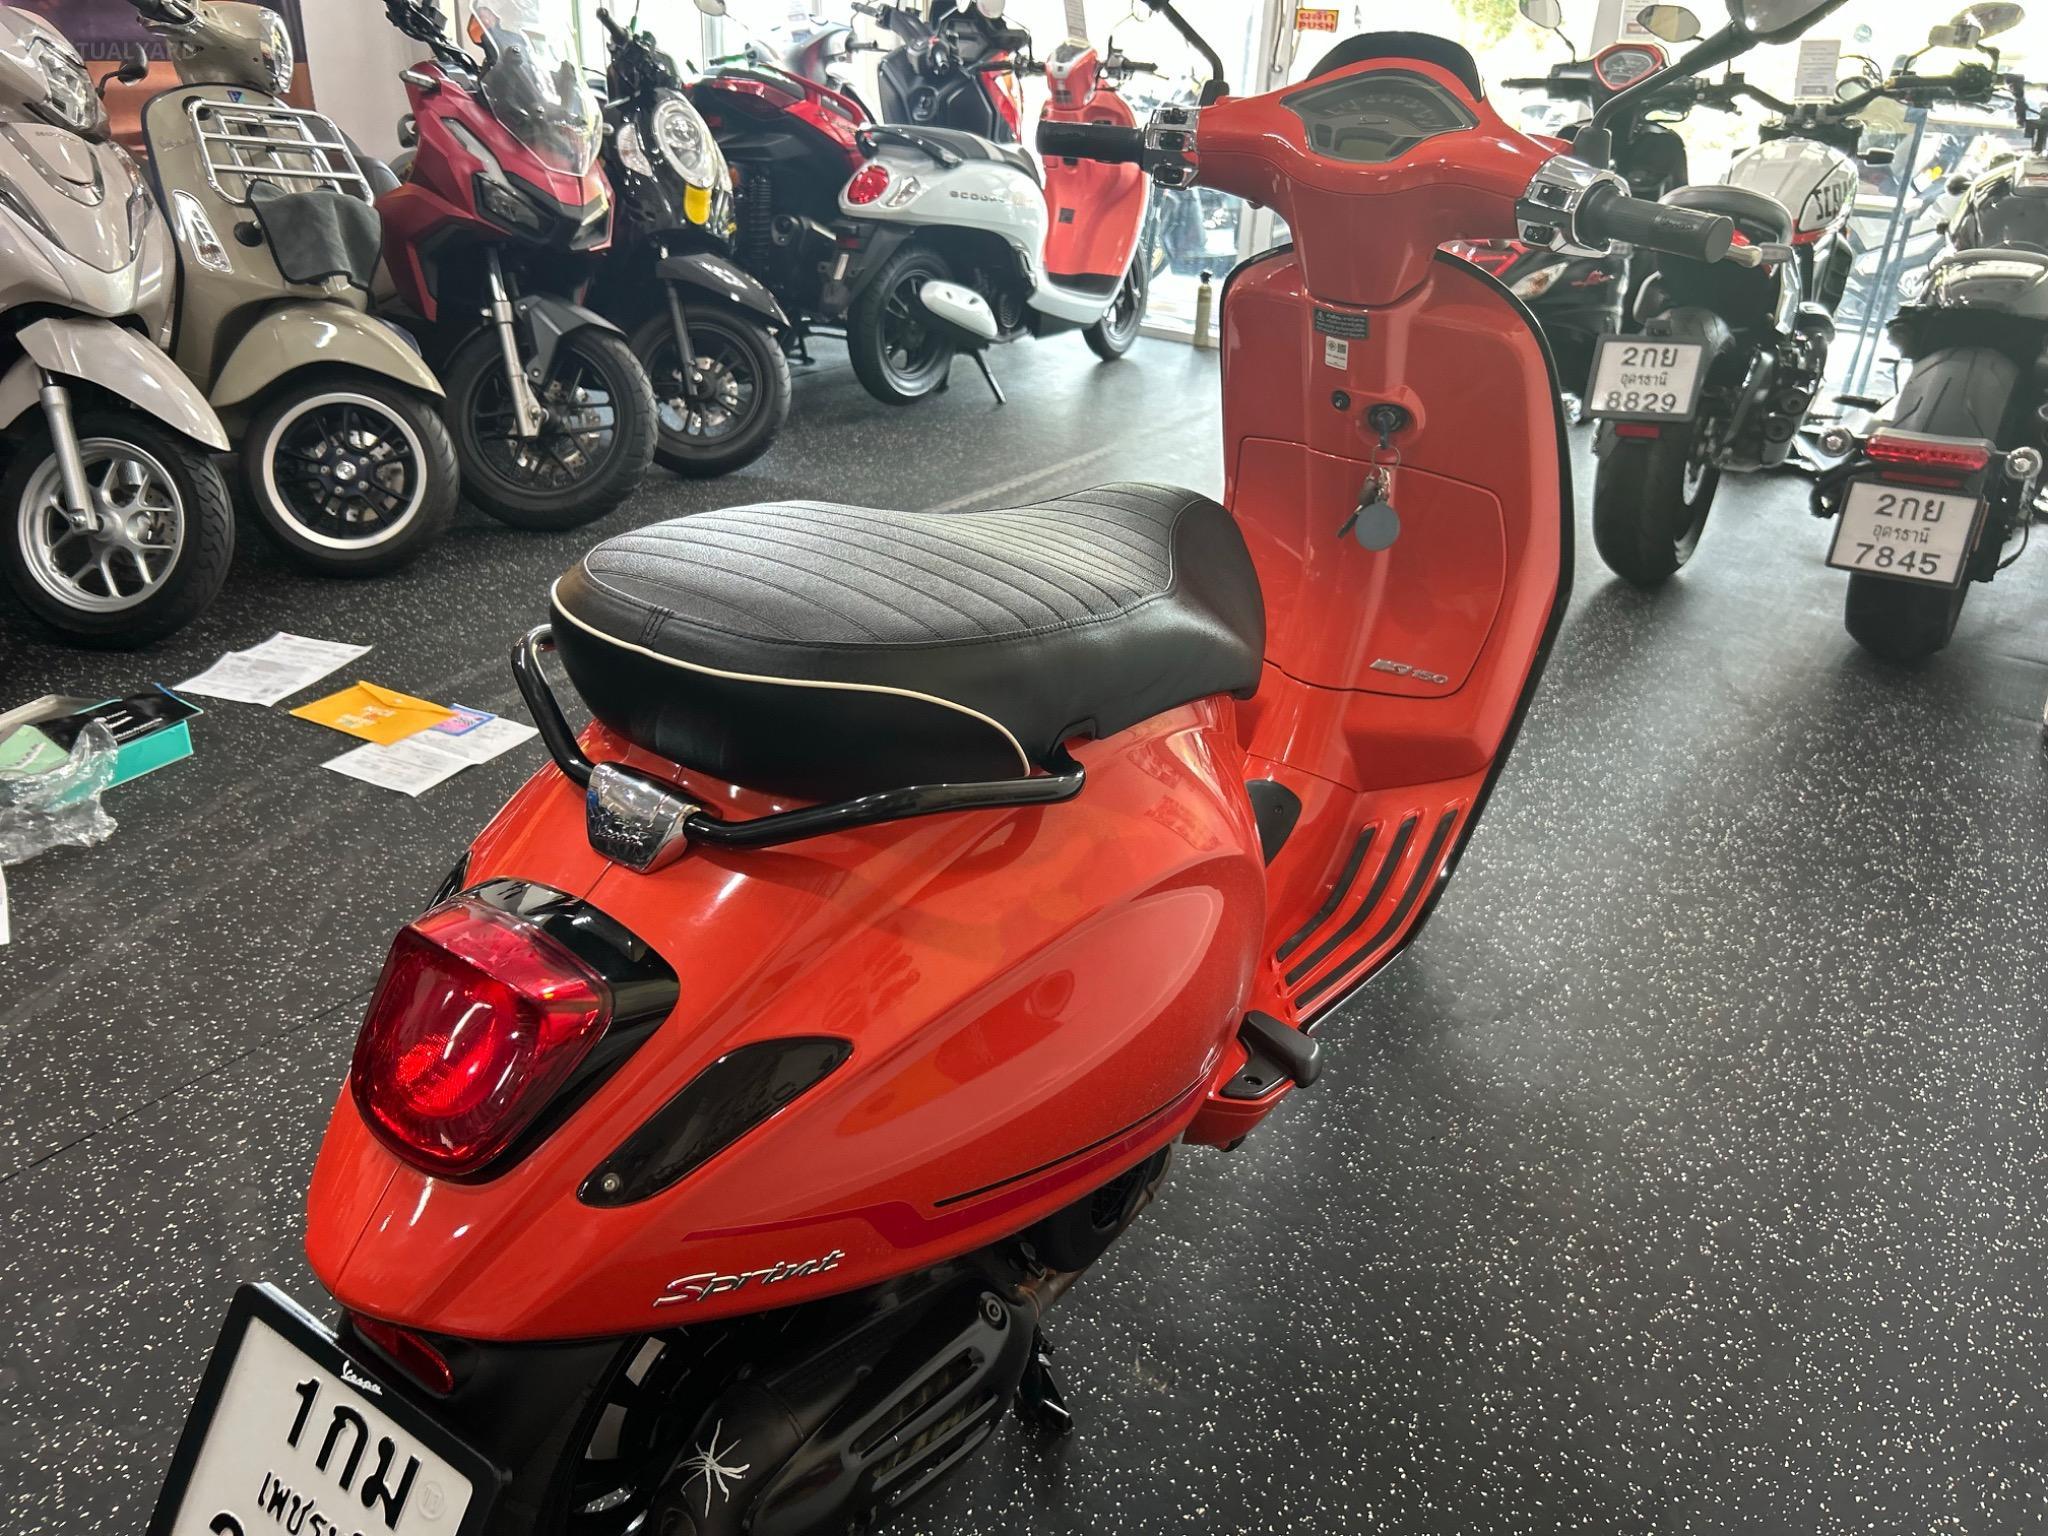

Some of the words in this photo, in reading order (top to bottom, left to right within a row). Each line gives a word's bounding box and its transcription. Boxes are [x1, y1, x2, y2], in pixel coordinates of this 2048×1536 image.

[1298, 21, 1335, 31] PUSH
[1620, 345, 1678, 368] 2กย
[1606, 391, 1677, 413] 8829
[1874, 493, 1945, 523] 2กย
[1872, 523, 1930, 545] อุดรธานี
[1854, 542, 1941, 576] 7845
[652, 1248, 846, 1308] Sprint
[340, 1359, 383, 1396] Vespa
[286, 1376, 422, 1531] 1กม
